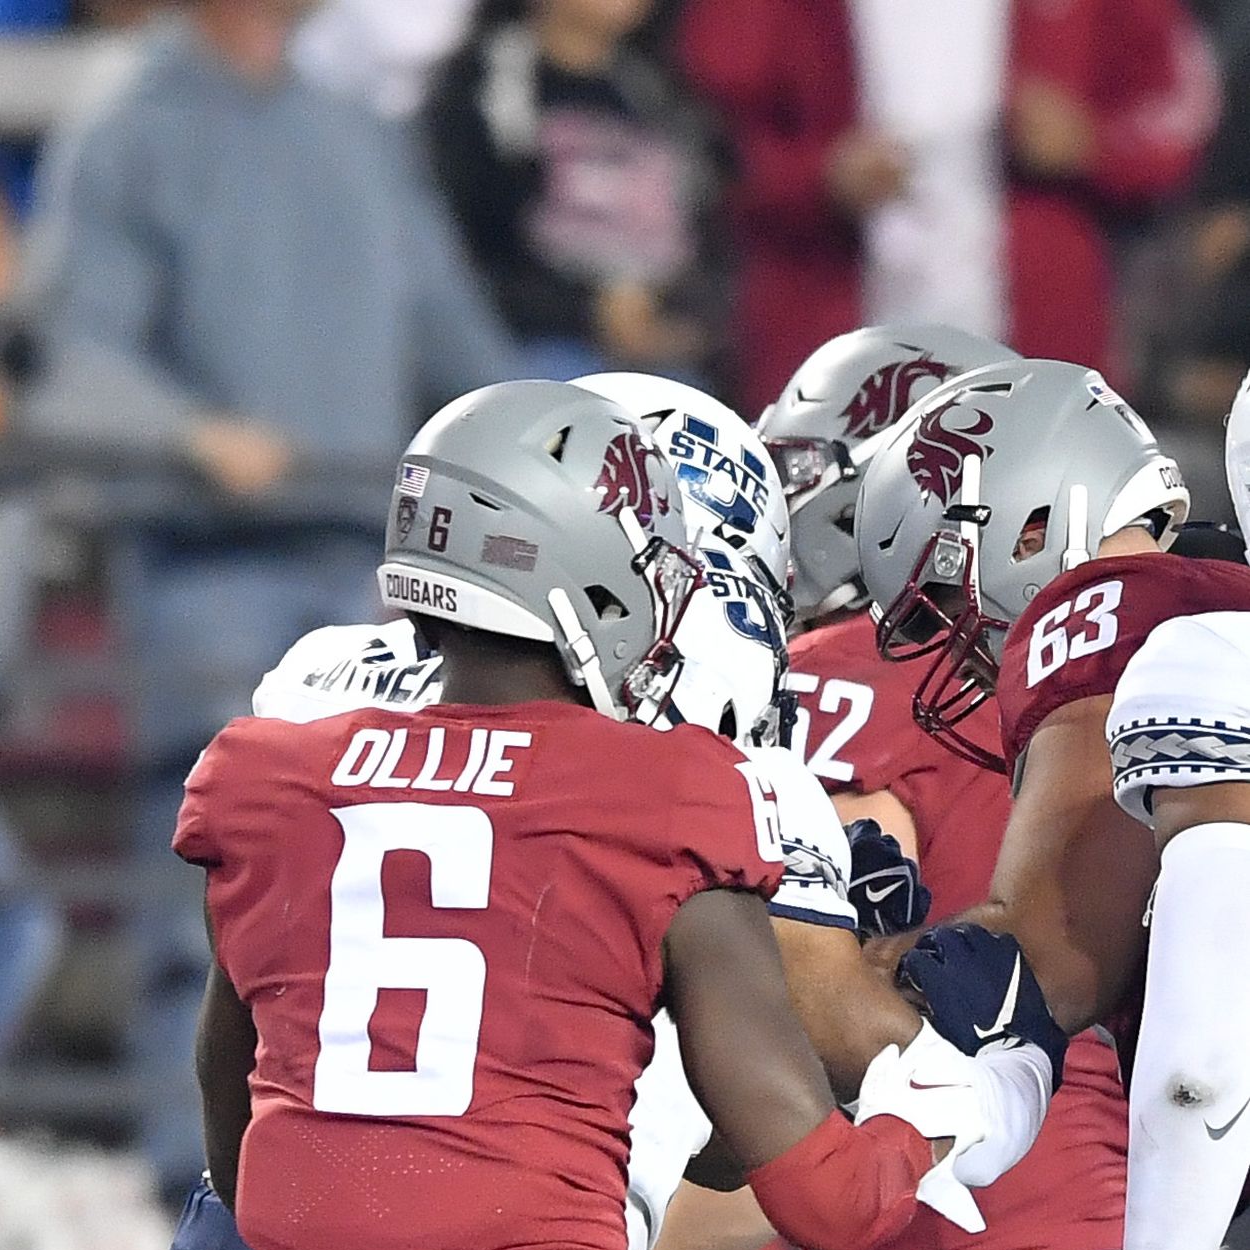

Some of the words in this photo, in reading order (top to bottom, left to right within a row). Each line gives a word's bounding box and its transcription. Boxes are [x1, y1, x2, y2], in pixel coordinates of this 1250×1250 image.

[669, 431, 769, 518] STATE
[428, 506, 453, 553] 6
[386, 573, 458, 613] COUGARS
[1025, 580, 1124, 690] 63
[330, 727, 532, 798] OLLIE
[312, 802, 495, 1117] 6
